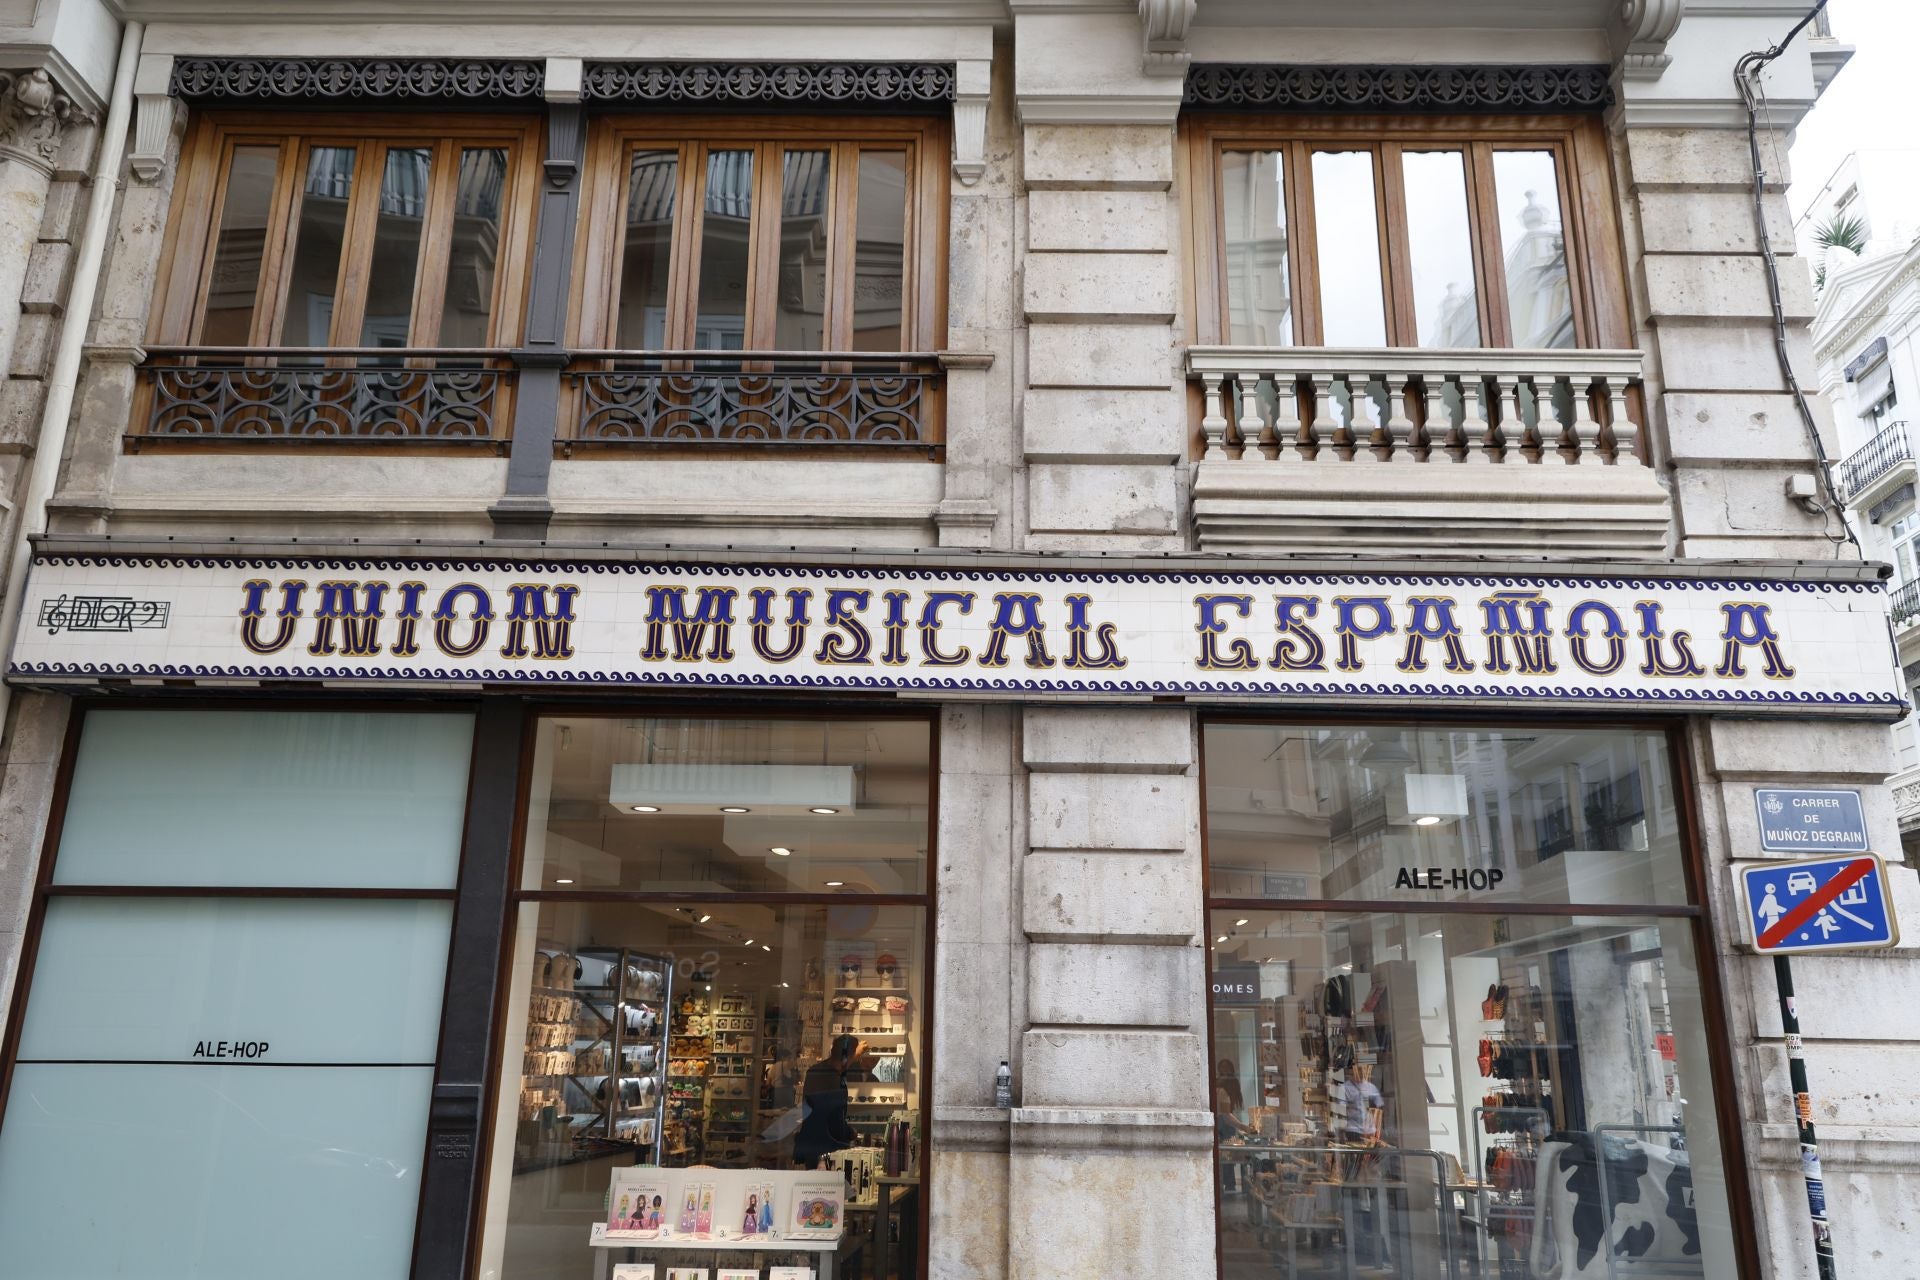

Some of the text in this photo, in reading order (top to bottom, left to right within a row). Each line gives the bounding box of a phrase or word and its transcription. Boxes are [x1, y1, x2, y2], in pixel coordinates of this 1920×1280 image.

[239, 579, 1796, 681] UNION MUSICAL ESPAÑOLA
[1792, 798, 1840, 808] CARRER
[1804, 814, 1820, 824] DE
[1766, 827, 1862, 843] MUÑOZ DEGRAIN
[1395, 867, 1504, 891] ALE-HOP
[193, 1041, 269, 1058] ALE-HOP
